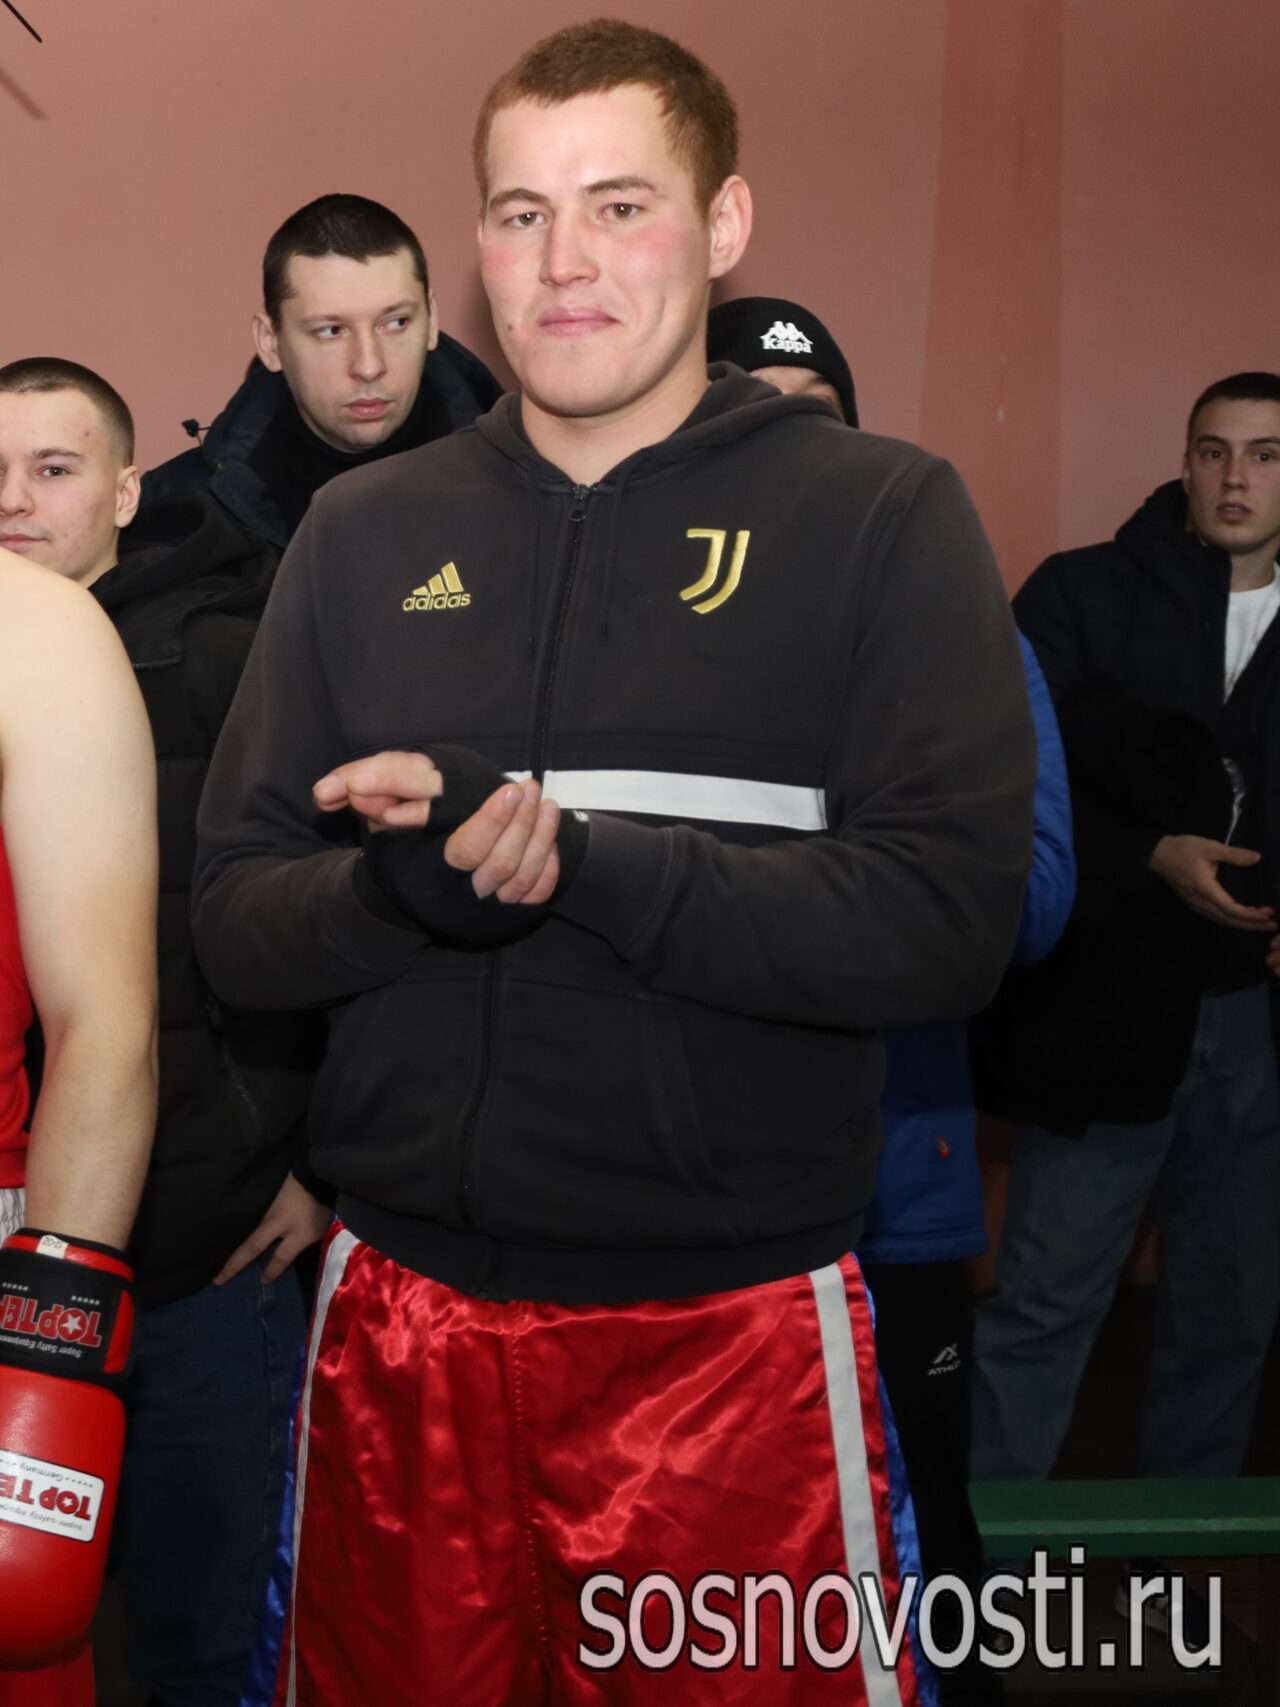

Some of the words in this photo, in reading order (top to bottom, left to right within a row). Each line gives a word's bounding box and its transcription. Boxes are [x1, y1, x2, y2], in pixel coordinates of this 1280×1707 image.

[763, 338, 813, 353] Kappa
[402, 591, 472, 612] adidas
[38, 1486, 92, 1521] TOP
